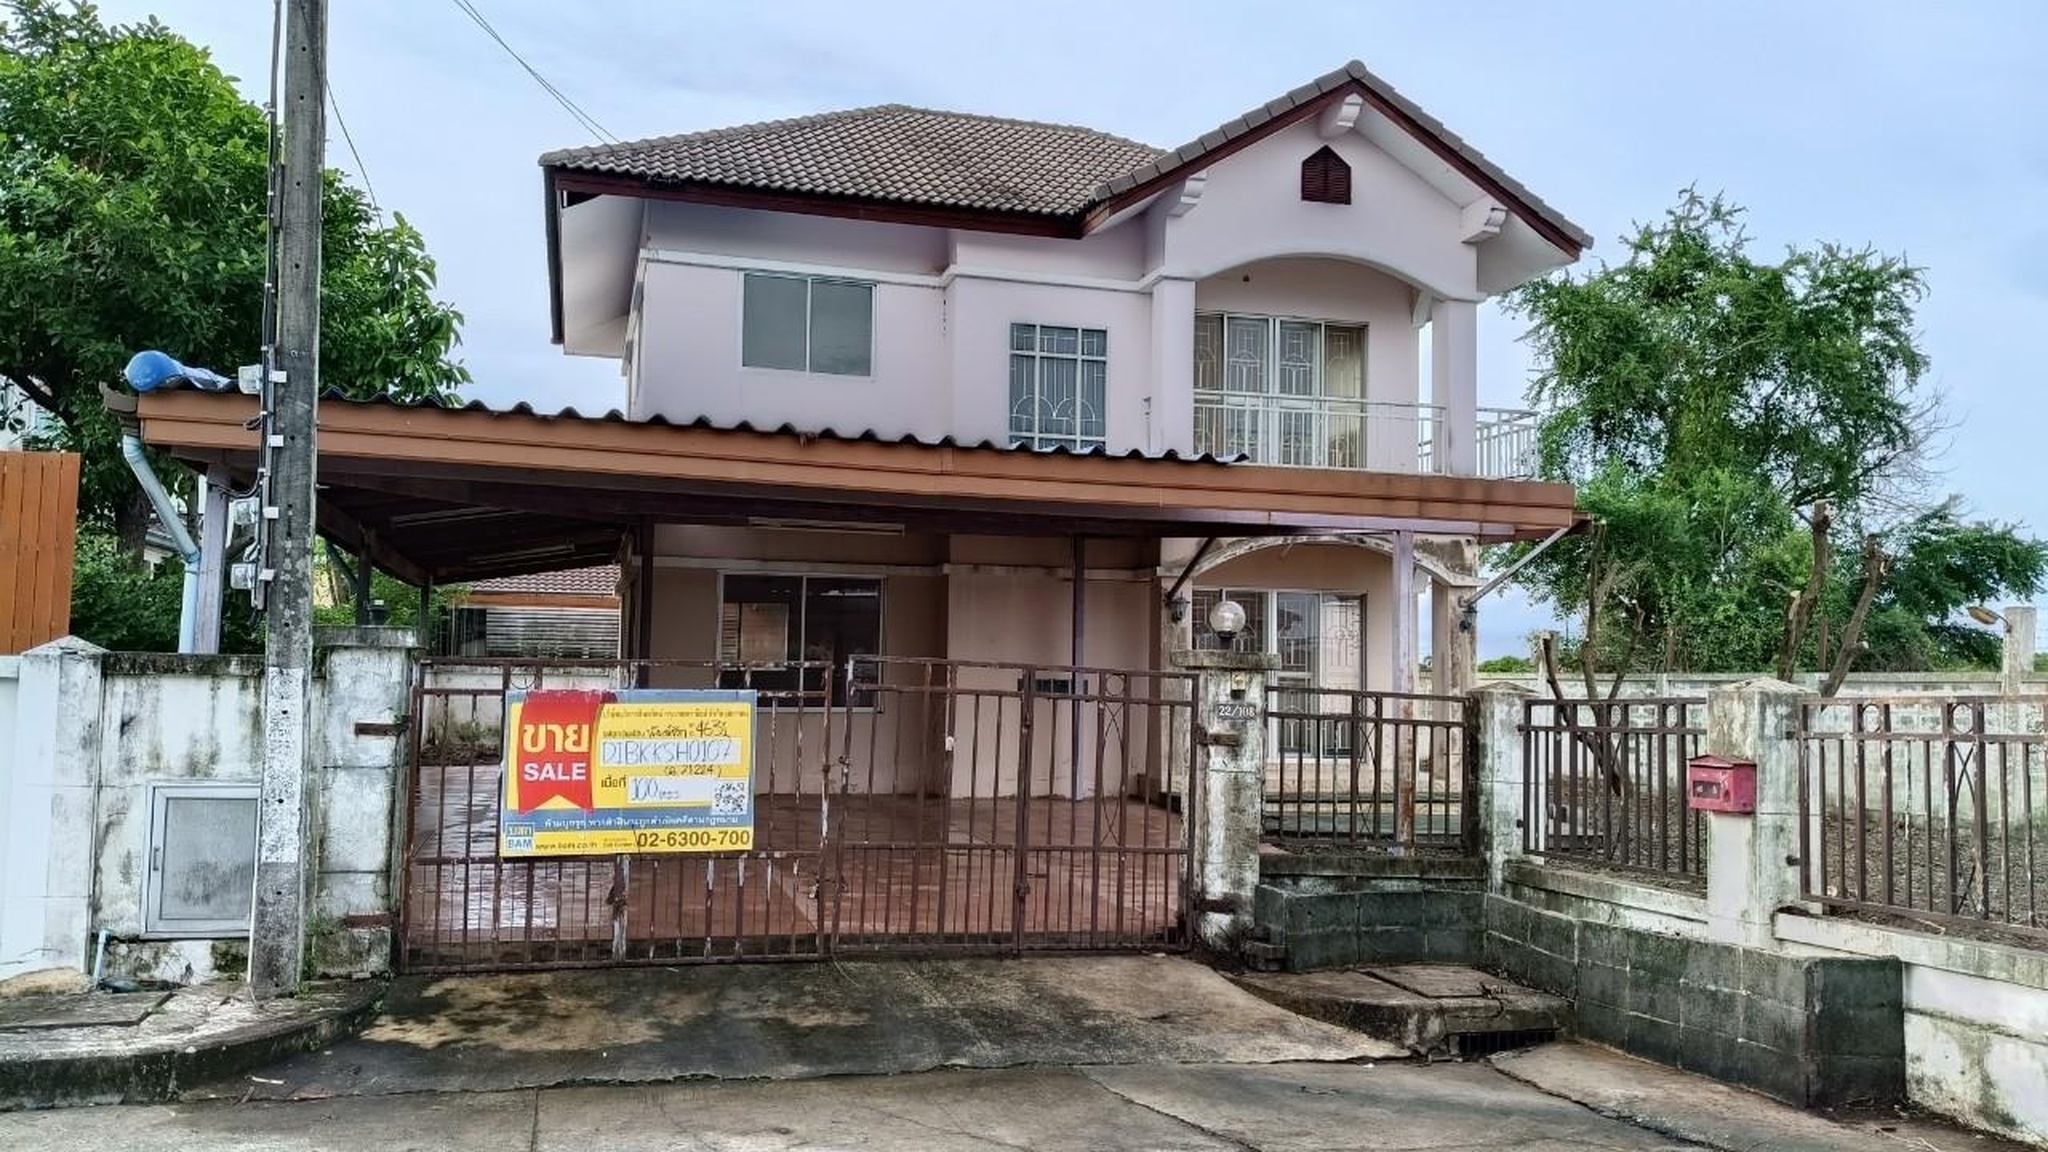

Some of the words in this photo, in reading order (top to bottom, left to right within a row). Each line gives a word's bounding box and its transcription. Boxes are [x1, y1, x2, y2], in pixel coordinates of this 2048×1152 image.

[522, 723, 590, 753] ขาย
[523, 761, 587, 782] SALE
[600, 773, 627, 788] เนื้อที่
[507, 838, 533, 849] BAM
[637, 830, 750, 848] 02-6300-700
